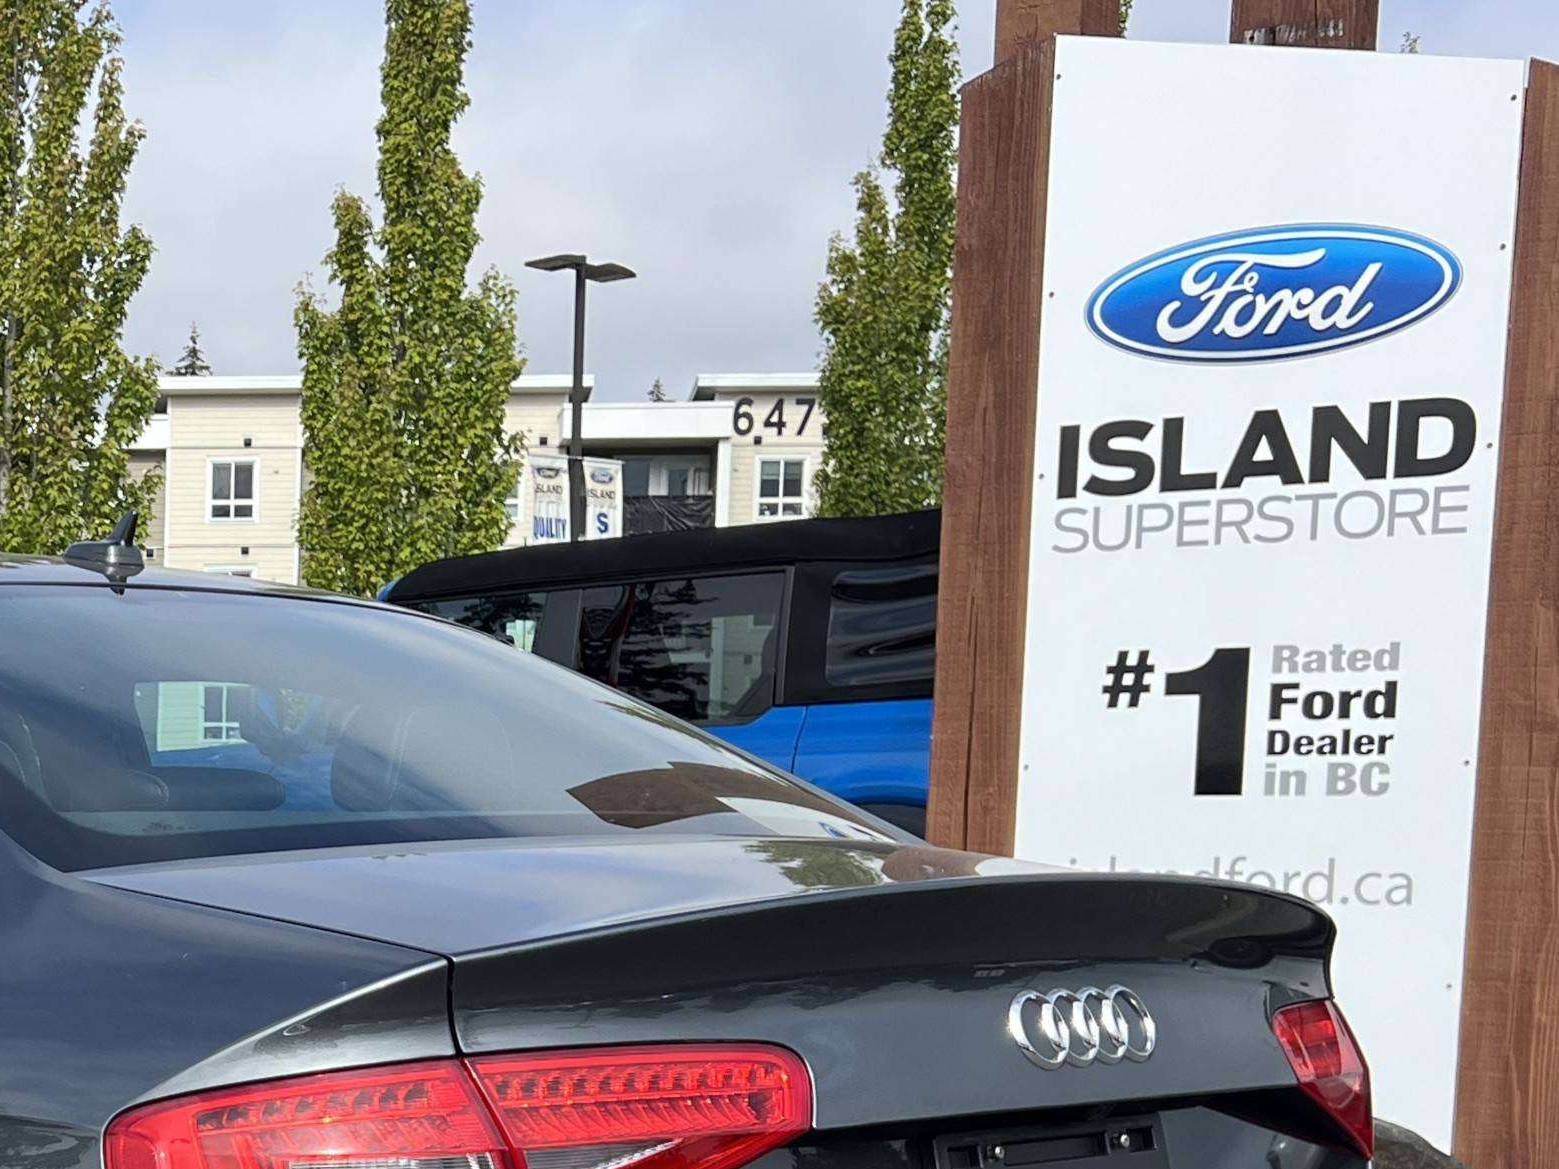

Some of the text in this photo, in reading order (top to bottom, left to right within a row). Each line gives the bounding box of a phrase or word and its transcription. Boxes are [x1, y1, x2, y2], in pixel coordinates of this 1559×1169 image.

[1156, 248, 1383, 343] Ford
[733, 397, 817, 436] 647
[1056, 397, 1477, 500] ISLAND
[1051, 484, 1470, 554] SUPERSTORE
[1271, 641, 1401, 674] Rated
[1268, 680, 1398, 721] Ford
[1266, 728, 1395, 756] Dealer
[1263, 761, 1391, 797] in BC
